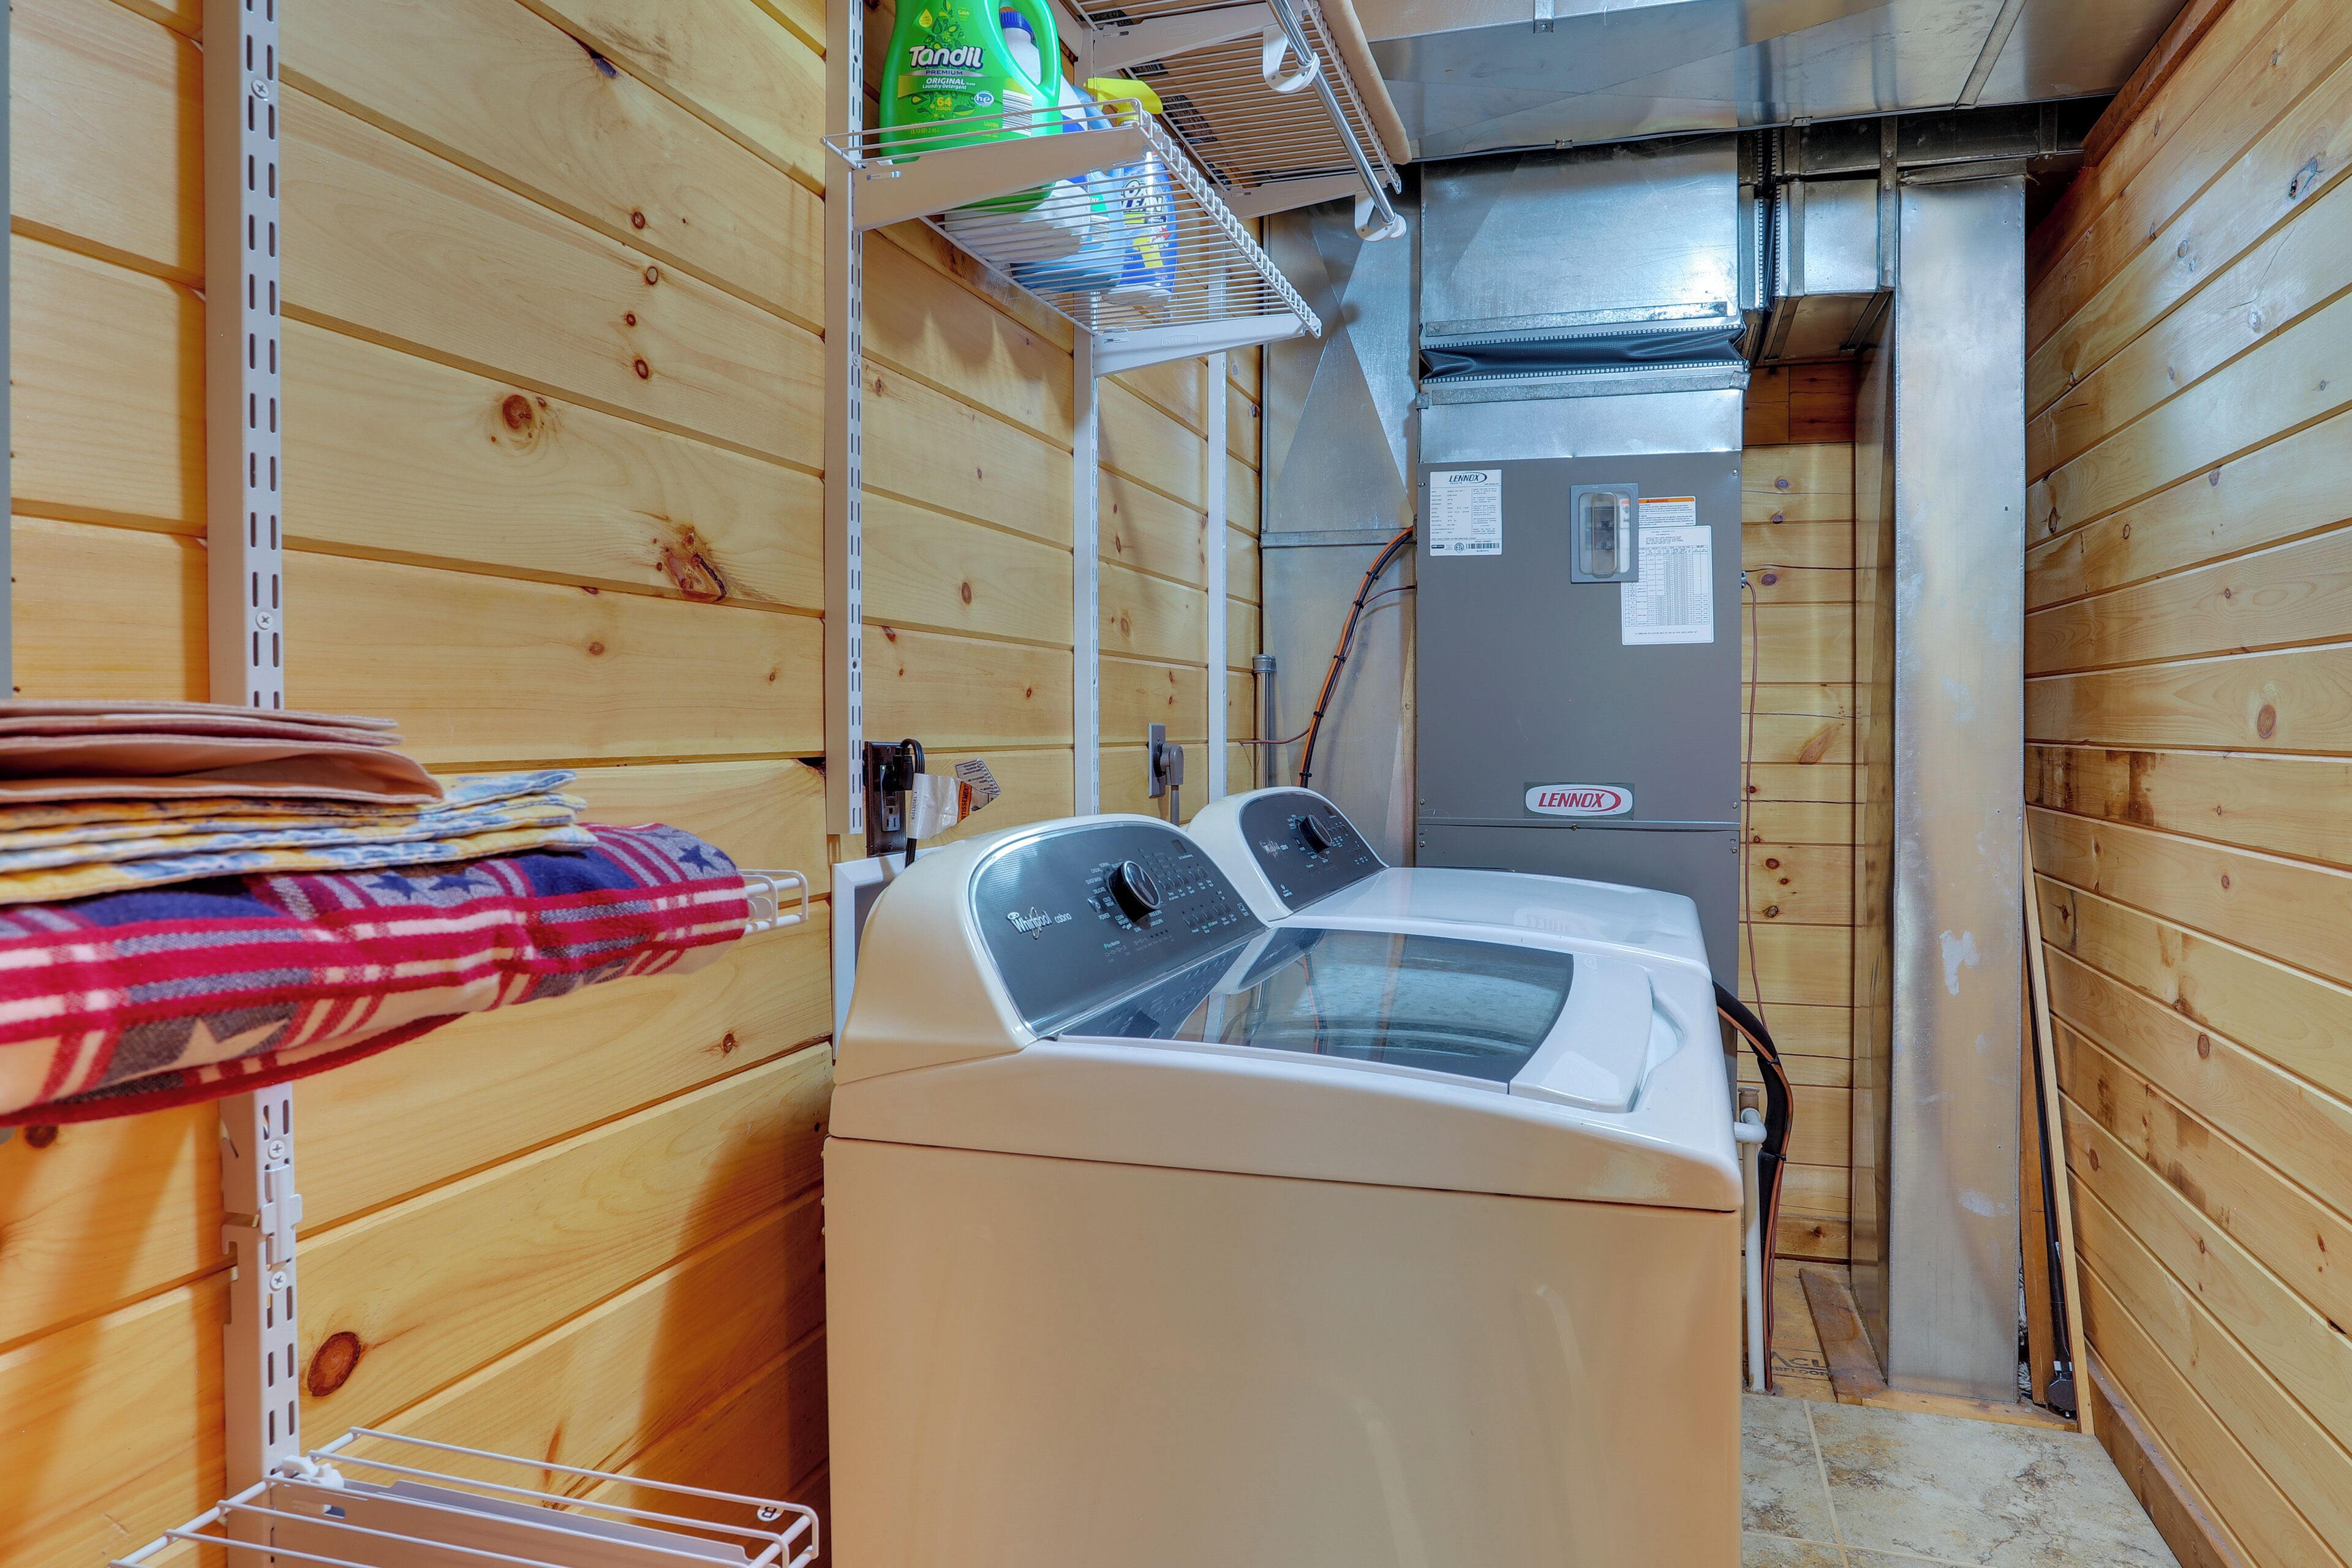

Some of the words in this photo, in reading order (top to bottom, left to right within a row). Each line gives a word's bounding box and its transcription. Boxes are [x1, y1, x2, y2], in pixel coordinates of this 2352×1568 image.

[909, 45, 983, 69] Tandil
[937, 97, 952, 107] 64
[976, 94, 991, 103] he
[1121, 196, 1163, 213] LEAN
[1539, 793, 1605, 808] LENNOX
[1008, 909, 1053, 933] Whirlpool
